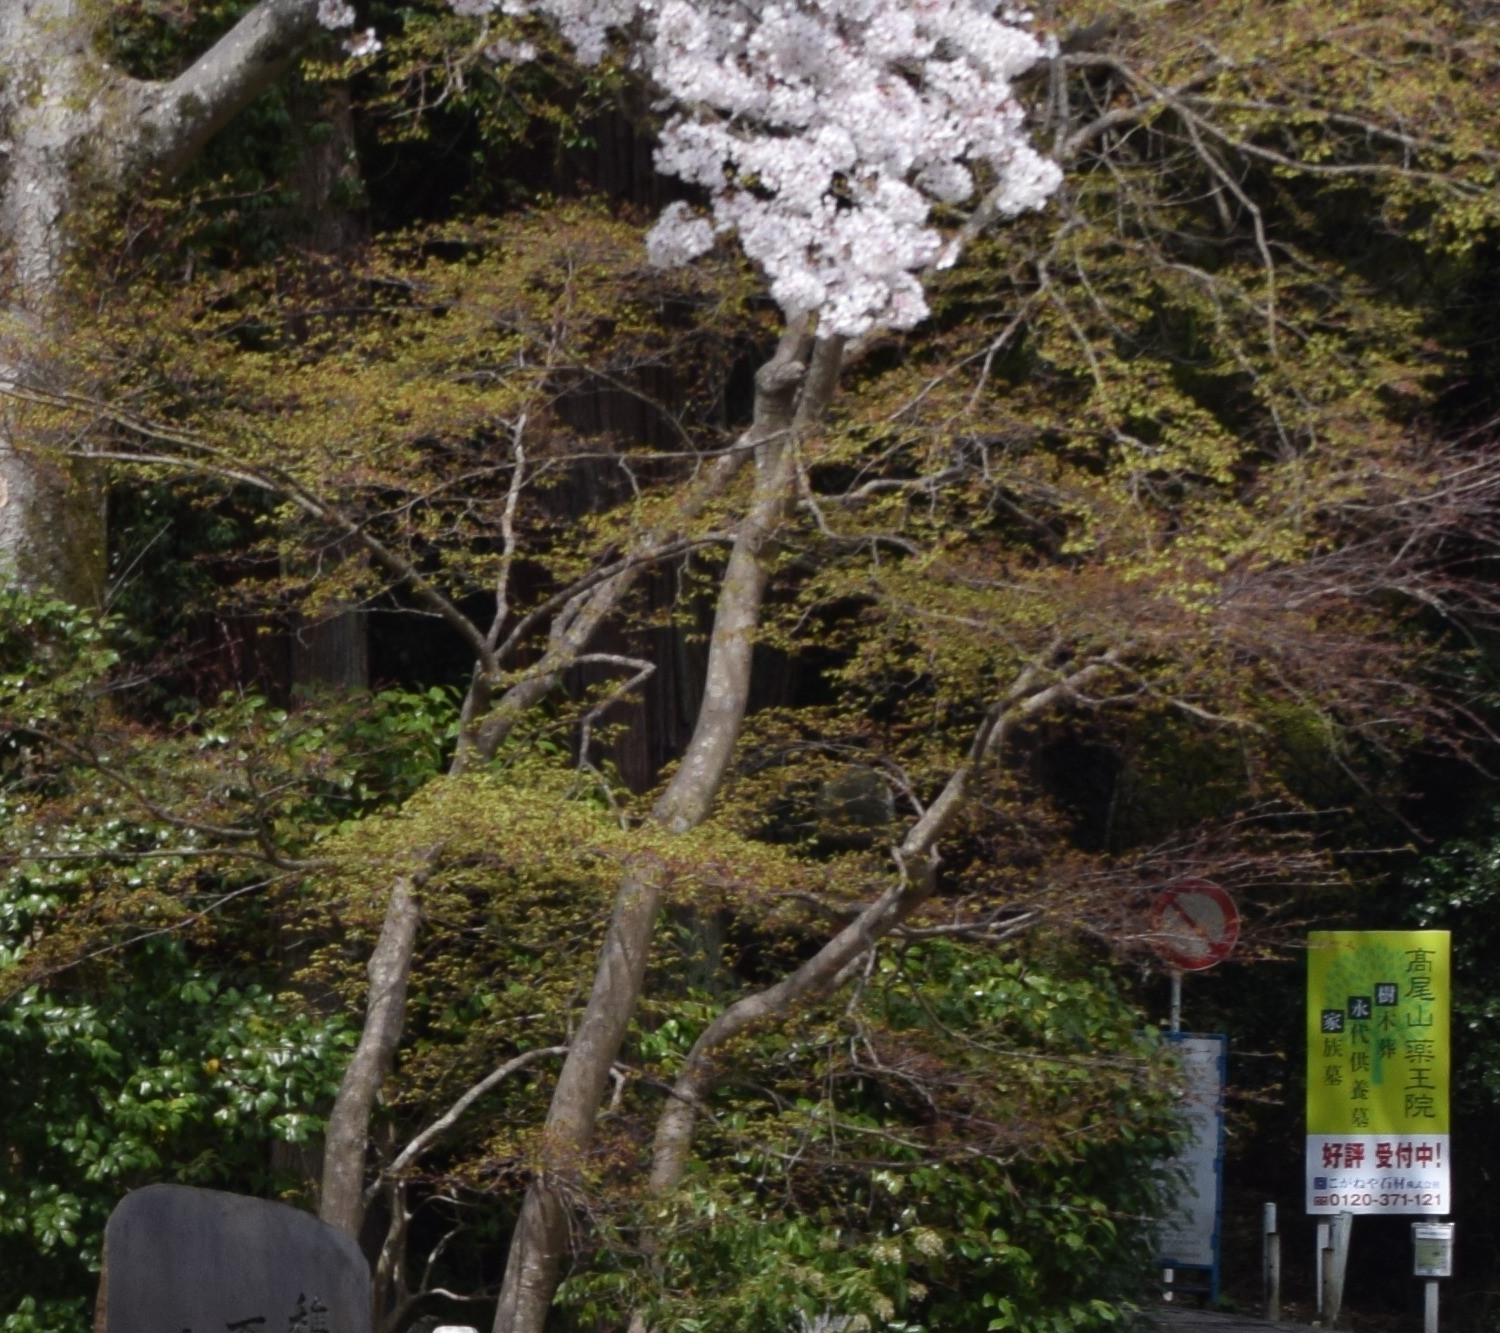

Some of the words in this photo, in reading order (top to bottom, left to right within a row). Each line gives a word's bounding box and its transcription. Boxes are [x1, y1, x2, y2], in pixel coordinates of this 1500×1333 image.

[1322, 1012, 1343, 1086] 家族墓
[1322, 1142, 1364, 1168] 好評
[1330, 1194, 1441, 1206] 0120-371-121
